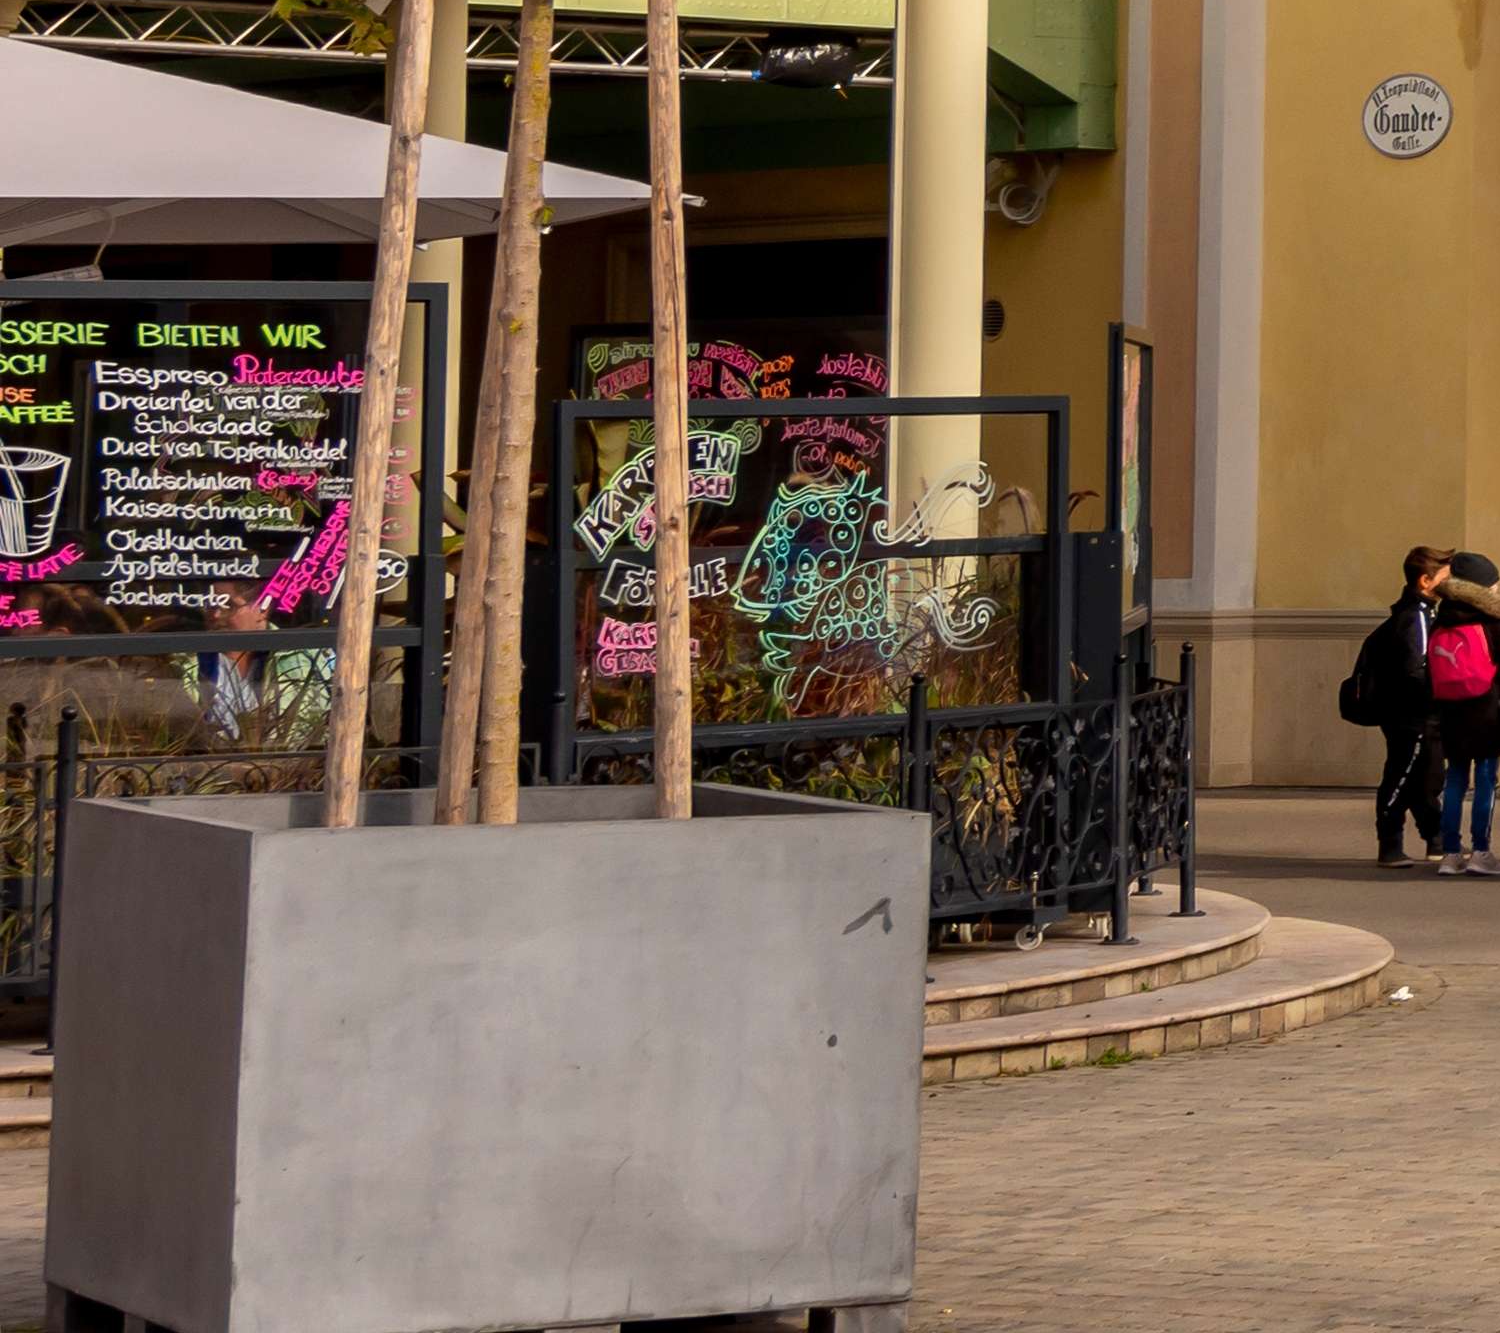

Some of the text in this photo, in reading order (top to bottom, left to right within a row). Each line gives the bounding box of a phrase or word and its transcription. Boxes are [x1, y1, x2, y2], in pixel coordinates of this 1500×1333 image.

[138, 323, 241, 348] BIETEN
[261, 323, 327, 350] WIR
[98, 389, 214, 414] Dreierlei
[262, 390, 309, 411] der
[134, 411, 275, 435] Schokolade
[101, 437, 161, 458] Duet
[207, 438, 348, 464] Topfenknödel
[101, 466, 253, 492] Palatschinken
[105, 495, 293, 521] Kaiserschmarrn
[106, 529, 248, 552] Obstkuchen
[105, 582, 232, 610] Sachertorte
